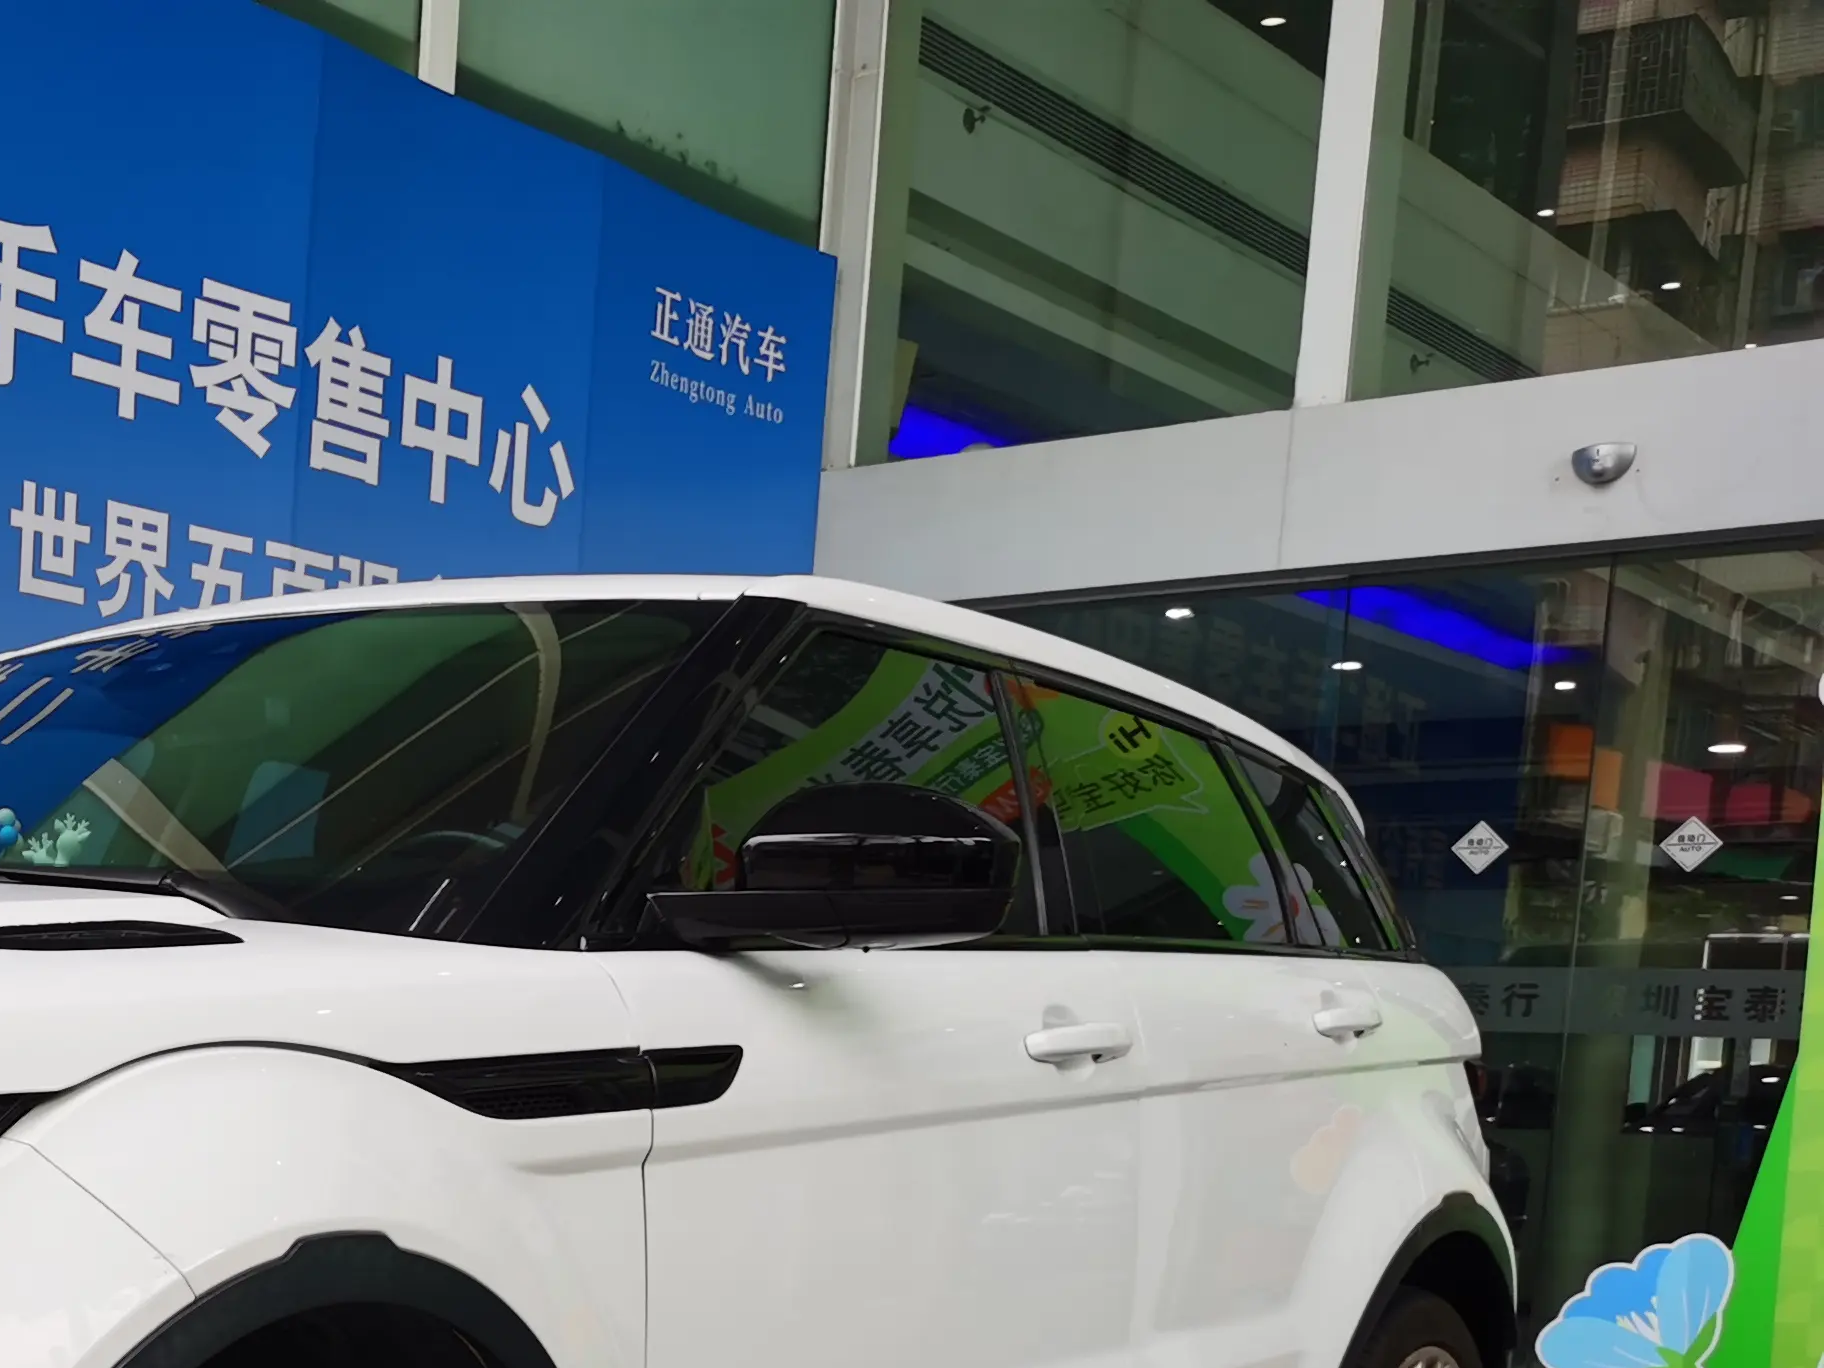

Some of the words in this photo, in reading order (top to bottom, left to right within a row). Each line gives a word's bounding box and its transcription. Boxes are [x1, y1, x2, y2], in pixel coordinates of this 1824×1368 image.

[651, 286, 787, 382] 正通汽车
[650, 359, 736, 415] Zhengtong
[744, 394, 784, 424] Auto
